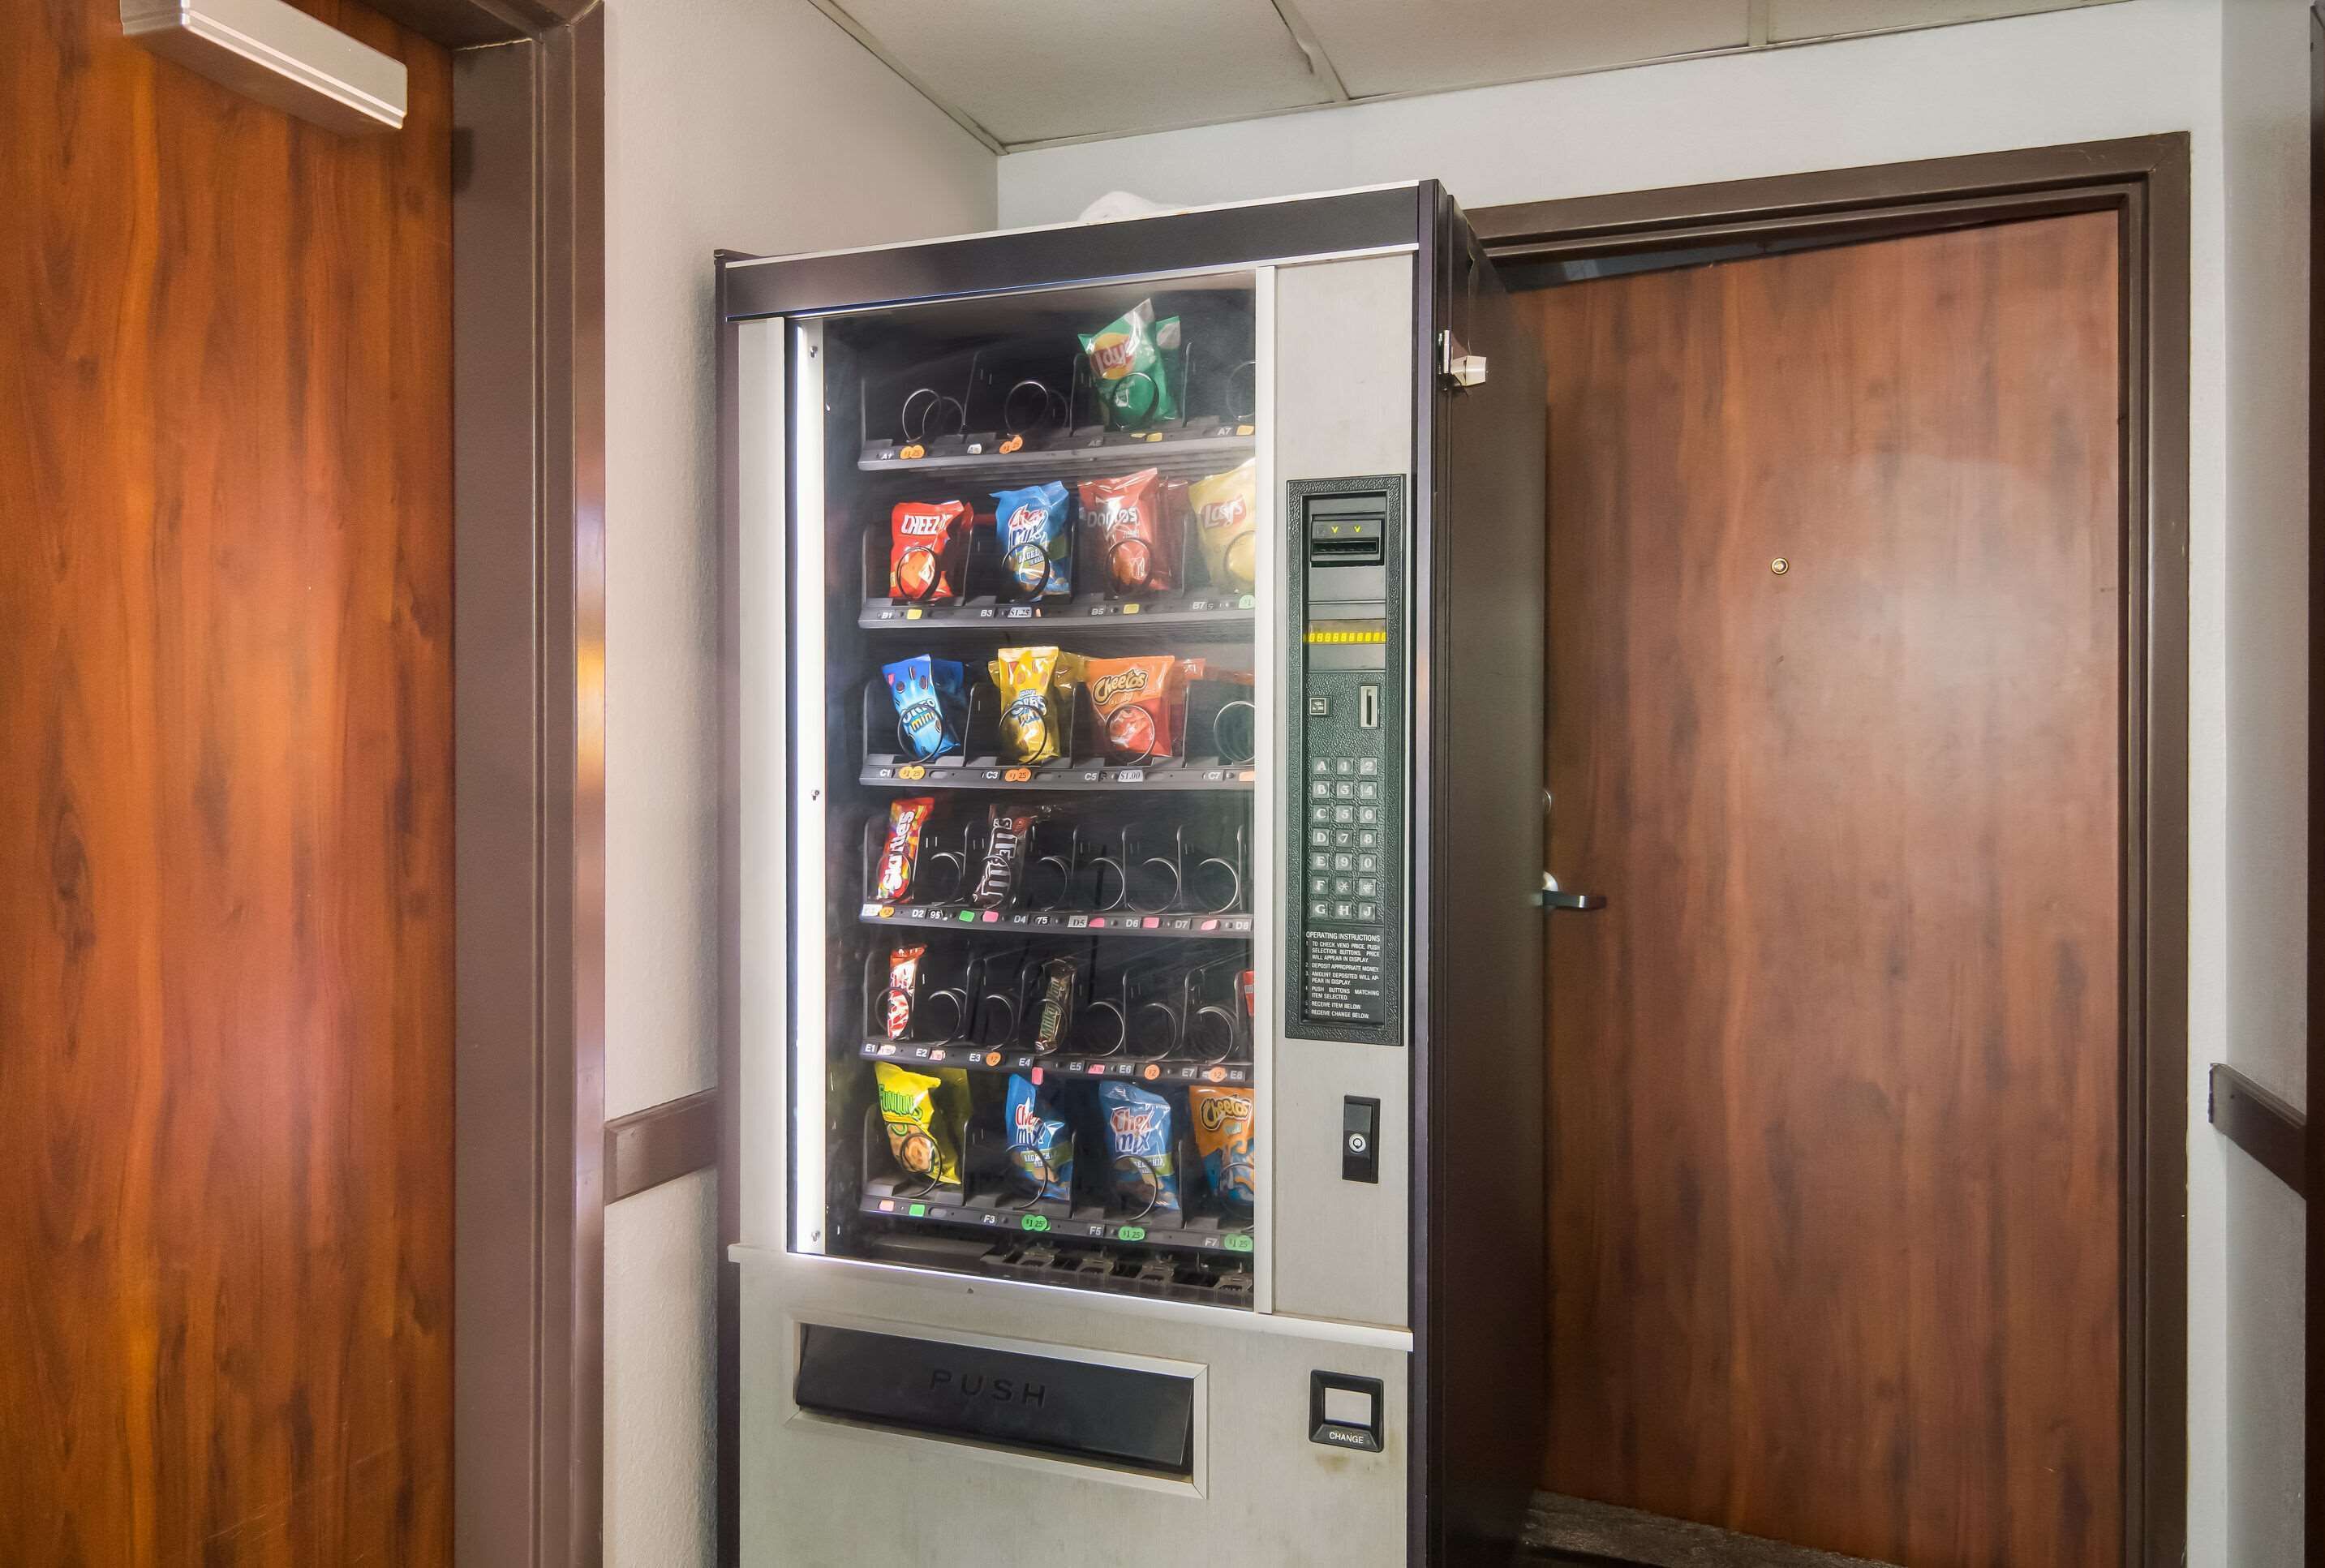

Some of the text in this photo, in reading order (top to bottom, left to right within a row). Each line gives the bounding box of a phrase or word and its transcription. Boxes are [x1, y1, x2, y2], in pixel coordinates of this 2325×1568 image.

[1094, 670, 1147, 703] Cheetos
[1317, 761, 1326, 771] A
[1364, 761, 1373, 771] 2
[1317, 784, 1326, 794] B
[1364, 785, 1373, 795] 4
[1316, 809, 1326, 818] C
[1342, 810, 1349, 818] 5
[1365, 810, 1373, 819] 6
[1317, 832, 1326, 842] D
[1339, 833, 1348, 843] 7
[1364, 834, 1373, 844] 8
[1317, 856, 1326, 866] E
[1340, 857, 1348, 866] 9
[1364, 858, 1372, 868] 0
[1317, 880, 1325, 891] F
[1315, 904, 1326, 914] G
[1339, 904, 1349, 915] H
[1364, 906, 1372, 916] J
[1126, 919, 1138, 927] D6
[1306, 931, 1380, 942] OPERATING INSTRUCTIONS
[865, 1044, 875, 1052] E1
[916, 1048, 927, 1057] E2
[969, 1054, 981, 1062] E3
[1019, 1059, 1030, 1067] E4
[1070, 1063, 1081, 1071] E5
[1120, 1065, 1131, 1073] E6
[1182, 1068, 1194, 1077] E7
[1231, 1071, 1243, 1079] E8
[1112, 1108, 1151, 1132] Chex
[1115, 1132, 1150, 1153] mix
[984, 1214, 995, 1223] F3
[1090, 1226, 1102, 1235] F5
[1205, 1238, 1218, 1246] F7
[930, 1369, 1046, 1408] PUSH
[1329, 1431, 1364, 1444] CHANGE
